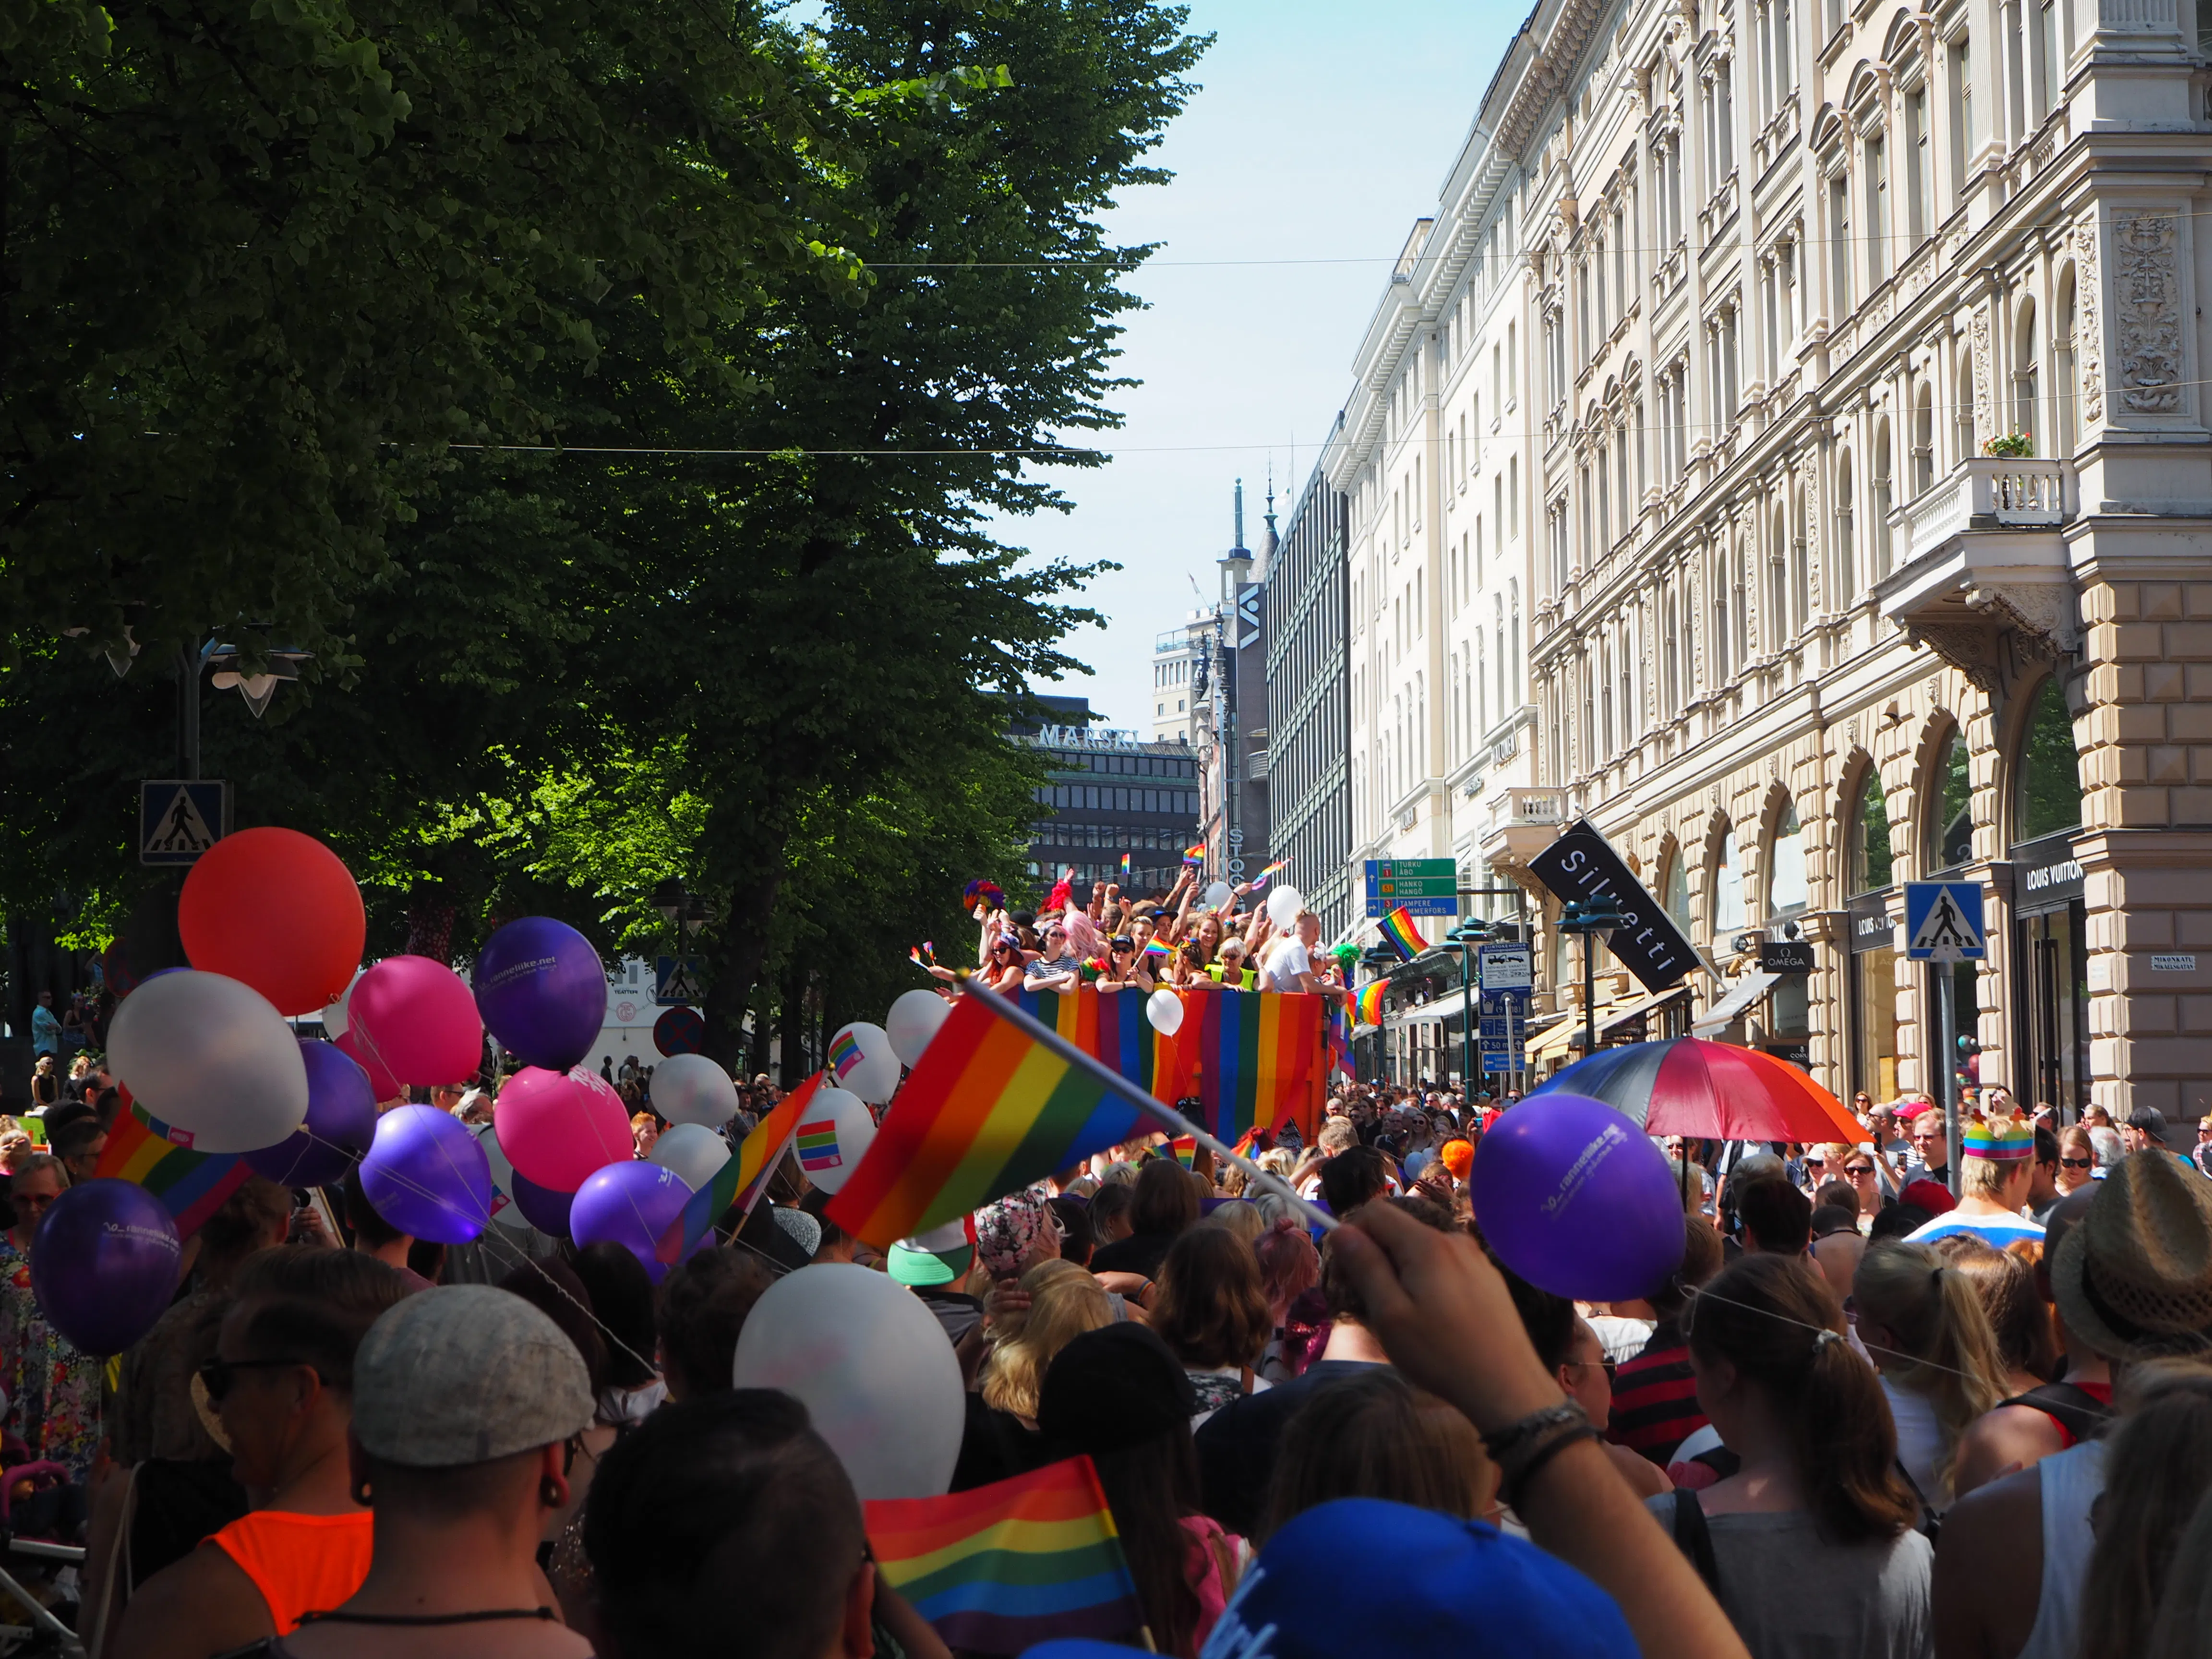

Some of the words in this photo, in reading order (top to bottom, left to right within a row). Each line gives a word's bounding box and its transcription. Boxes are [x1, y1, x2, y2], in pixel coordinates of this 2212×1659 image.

[1039, 723, 1139, 750] MARSKI
[2027, 866, 2049, 890] LOUIS
[2049, 859, 2083, 885] VUITTON
[1561, 850, 1675, 971] Siletti
[1858, 916, 1874, 936] LOUIS
[1767, 958, 1805, 966] OMEGA
